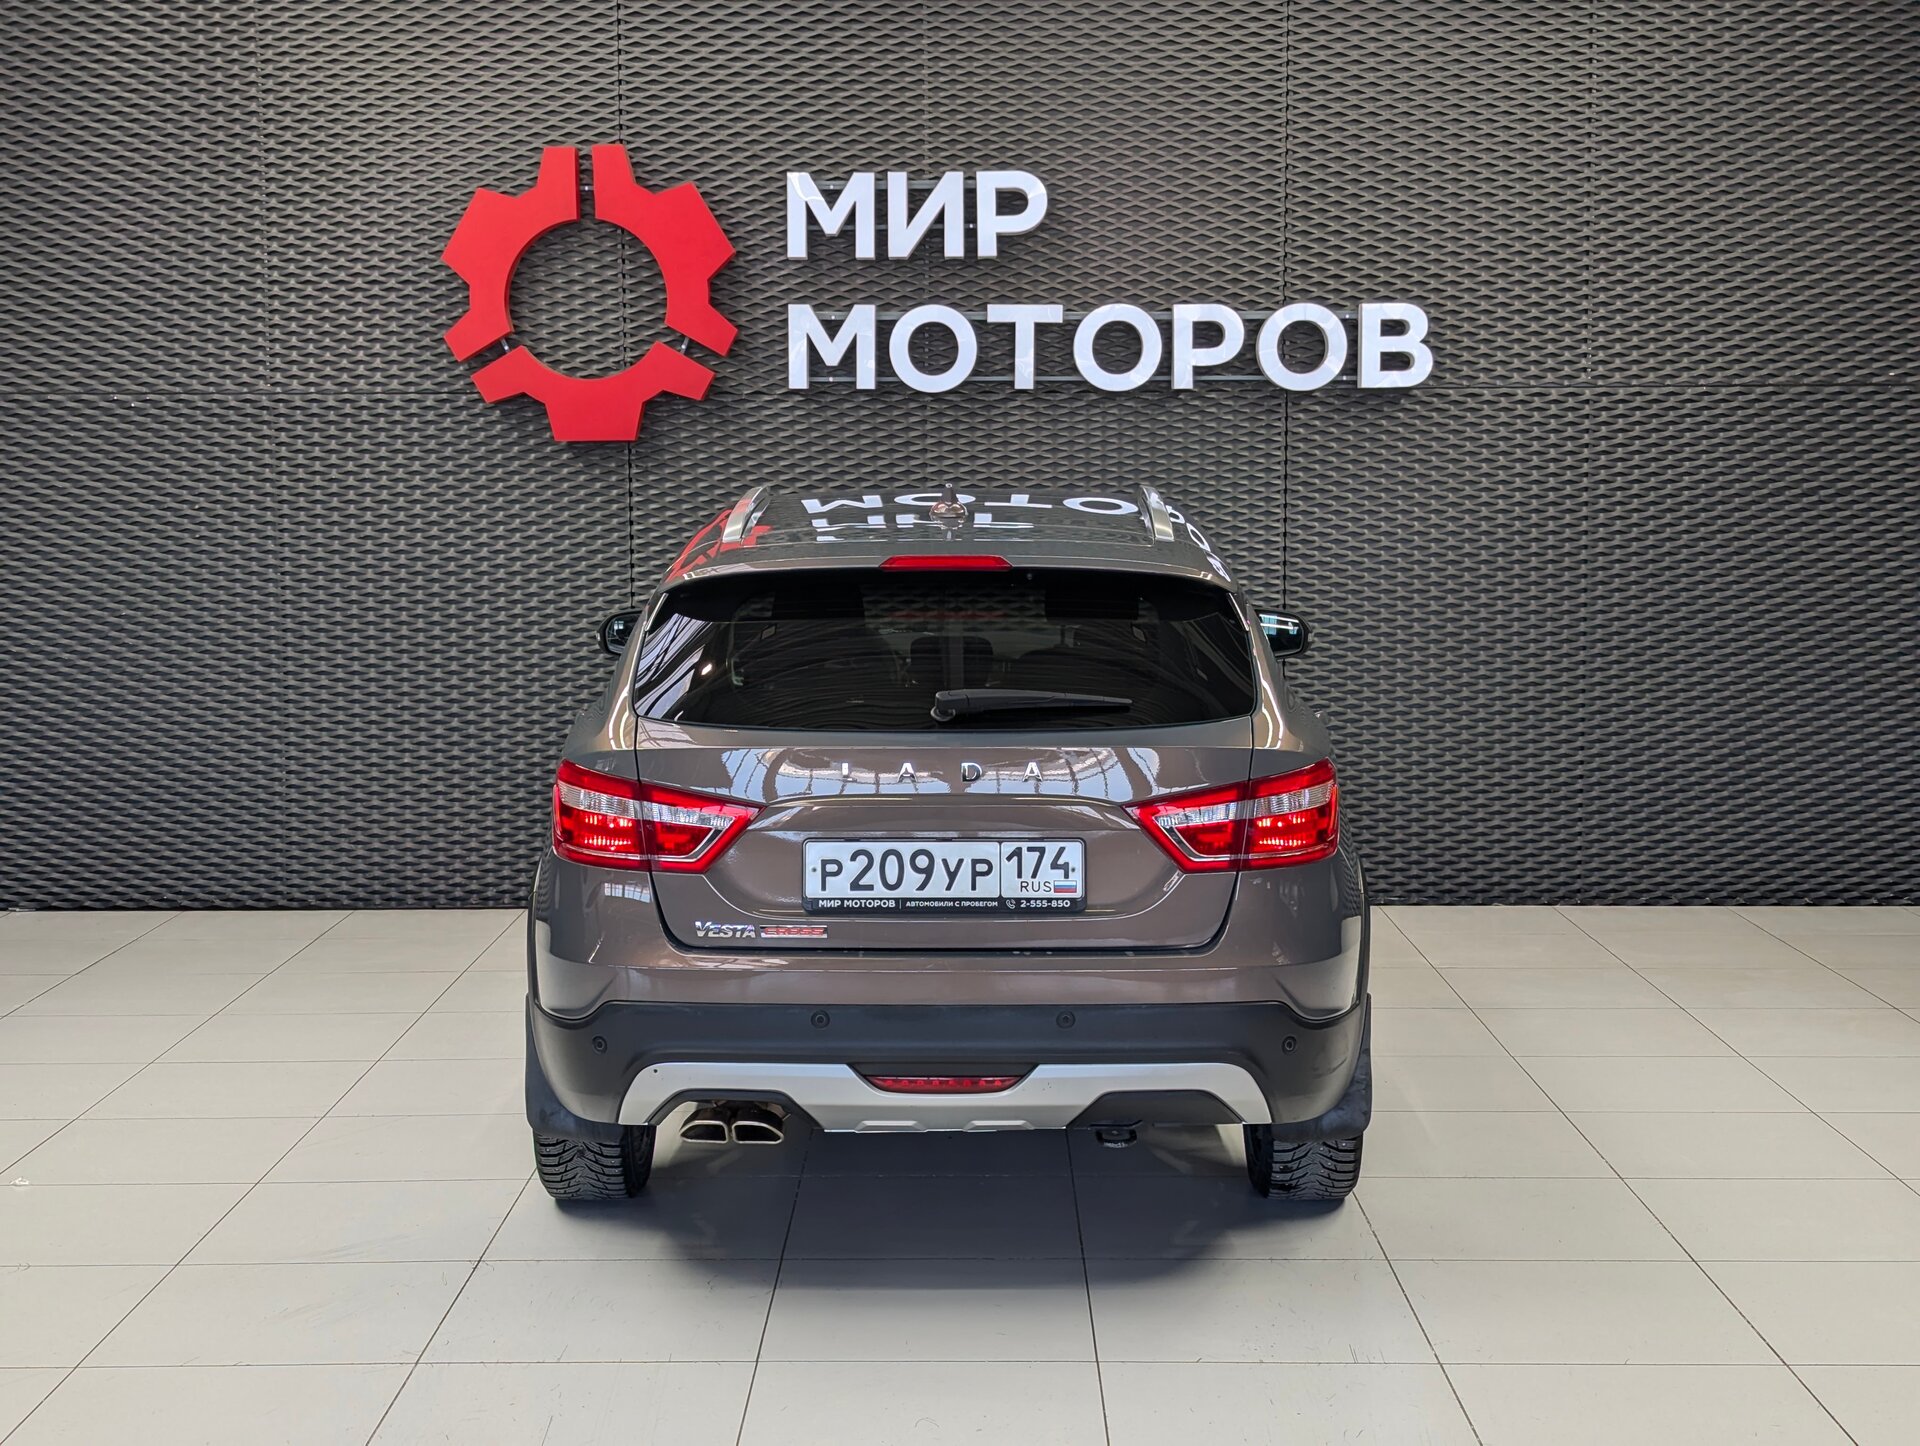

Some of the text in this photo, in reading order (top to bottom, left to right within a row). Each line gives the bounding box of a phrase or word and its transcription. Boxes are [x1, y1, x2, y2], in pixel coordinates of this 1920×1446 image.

[786, 171, 1048, 260] МИР
[787, 302, 1434, 393] МОТОРОВ
[842, 762, 1043, 782] LADA
[820, 846, 1070, 891] Р209УР 174
[1020, 880, 1052, 893] RUS
[819, 899, 841, 908] МИР
[844, 899, 896, 908] МОТОРОВ
[1020, 900, 1071, 908] 2-555-850
[695, 921, 756, 939] VESTA
